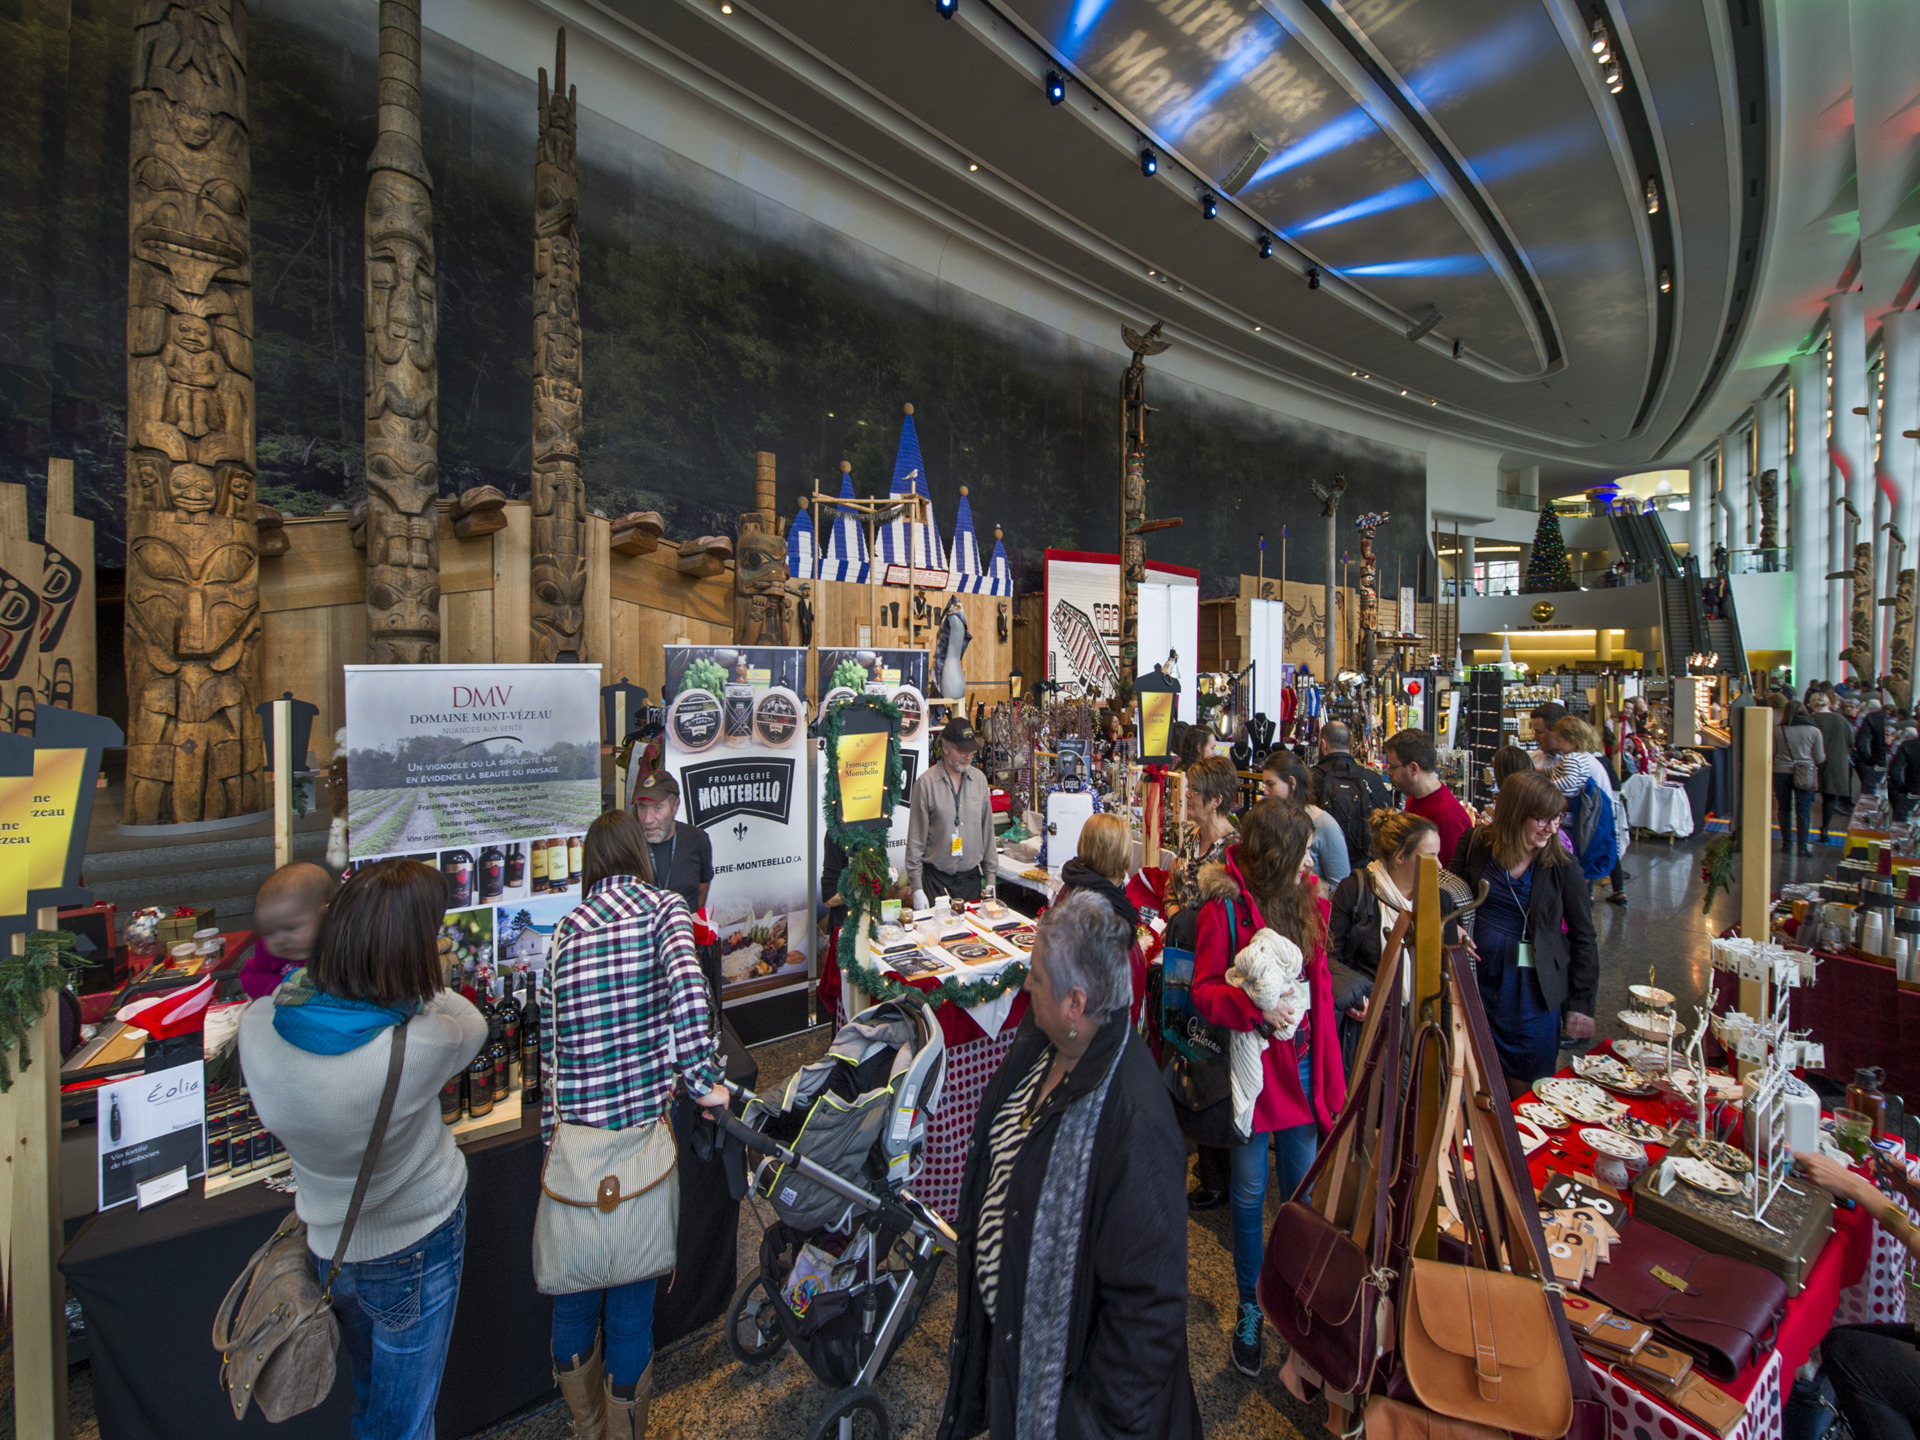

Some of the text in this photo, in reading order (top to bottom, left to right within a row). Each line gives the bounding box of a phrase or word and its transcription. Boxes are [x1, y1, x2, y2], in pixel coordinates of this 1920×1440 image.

[1091, 29, 1248, 156] Market
[452, 685, 513, 708] DMV
[410, 709, 552, 724] DOMAINE MONT-VÉZEAU
[442, 724, 523, 734] NUANCES AUX VENTS
[426, 761, 468, 771] VIGNOBLE
[471, 758, 483, 768] OÙ
[486, 759, 497, 767] LA
[499, 755, 540, 766] SIMPLICITÉ
[542, 755, 557, 763] MET
[845, 759, 878, 769] Fromagerie
[406, 776, 419, 784] EN
[421, 773, 463, 783] ÉVIDENCE
[479, 769, 510, 779] BEAUTÉ
[513, 769, 524, 777] DU
[526, 766, 559, 775] PAYSAGE
[708, 772, 771, 784] FROMAGERIE
[845, 768, 878, 777] Montebello
[428, 791, 460, 799] Domaine
[492, 786, 511, 794] pieds
[522, 784, 539, 792] vigne
[698, 781, 781, 811] MONTEBELLO
[417, 803, 448, 811] Fraisière
[460, 801, 476, 809] cinq
[529, 793, 549, 801] saison
[440, 819, 462, 828] Visites
[407, 834, 422, 842] Vins
[424, 832, 448, 842] primés
[147, 1078, 199, 1102] Éolia
[172, 1118, 202, 1131] Nouveau
[110, 1143, 149, 1161] Vin fortifié
[110, 1150, 160, 1170] de framboises
